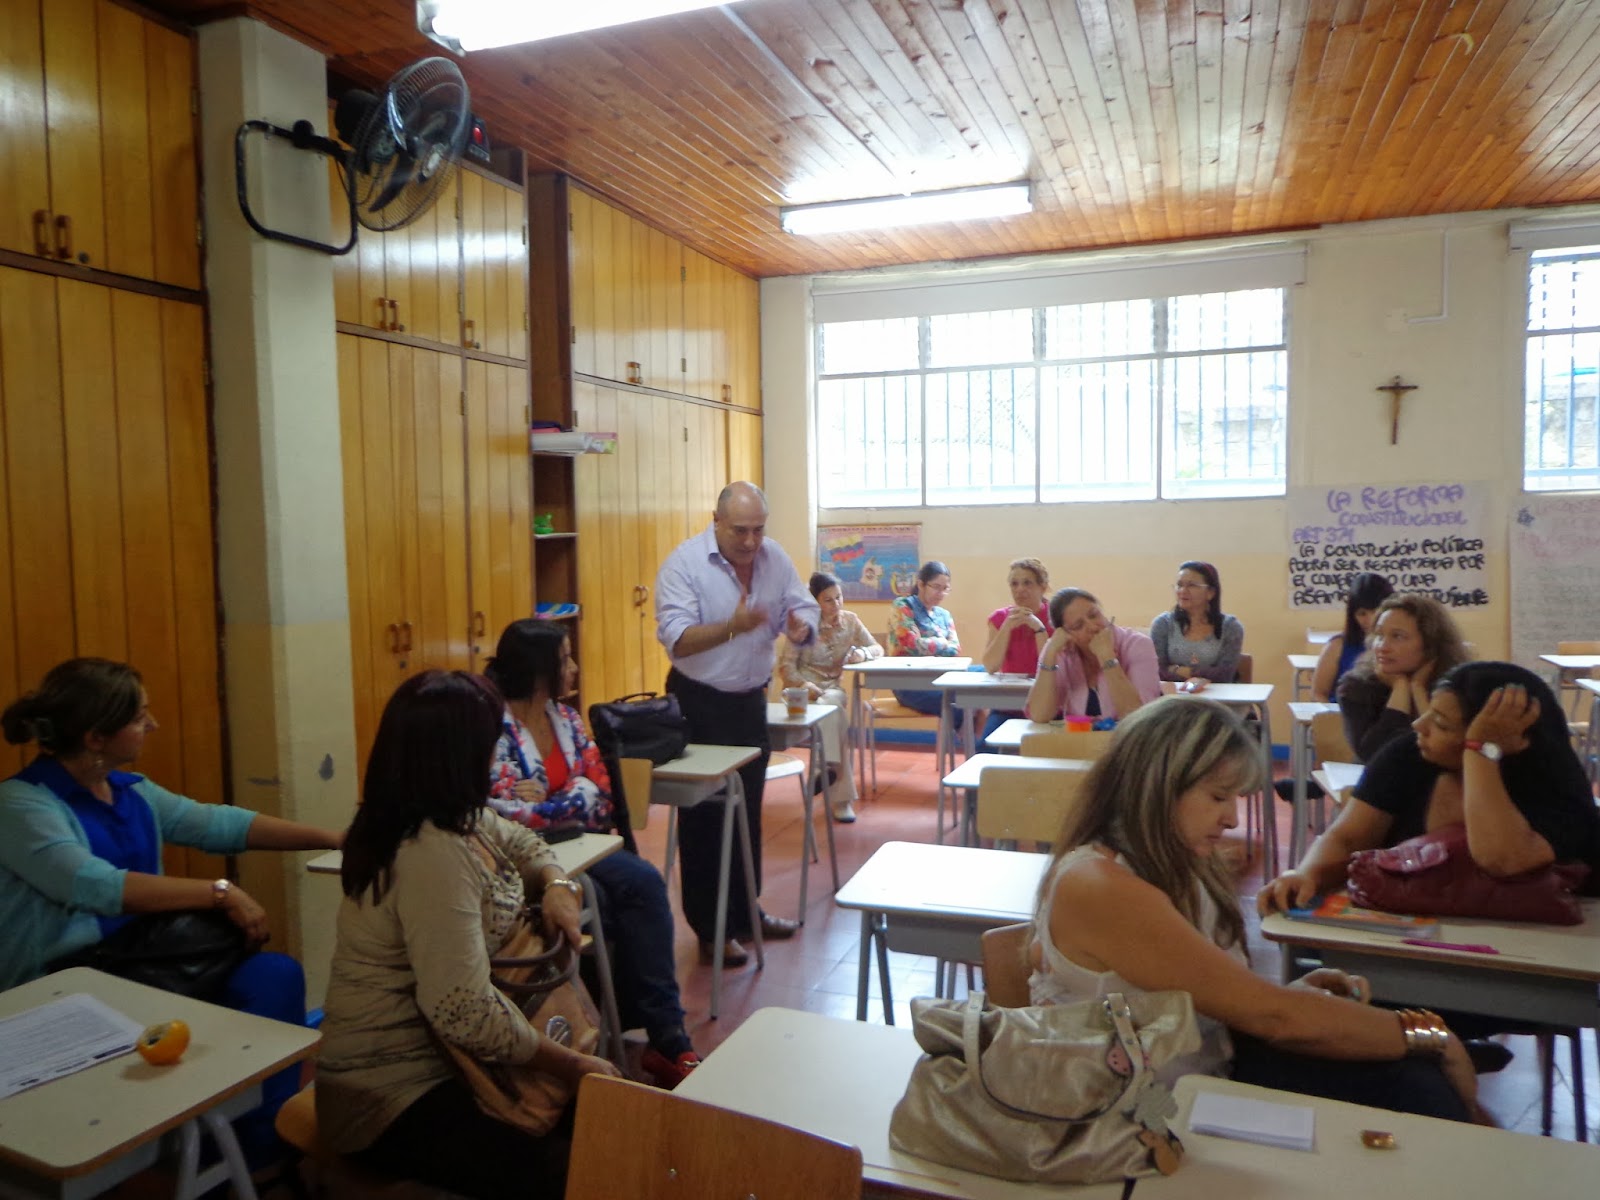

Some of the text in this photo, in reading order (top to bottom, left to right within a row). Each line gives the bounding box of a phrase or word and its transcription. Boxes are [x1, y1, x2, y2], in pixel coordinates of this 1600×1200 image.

[1327, 485, 1464, 513] LA REFORMA
[1300, 544, 1315, 558] LA
[1422, 535, 1483, 554] POLÍTICA
[1334, 558, 1360, 571] SER
[1364, 556, 1454, 572] REFORMADA
[1458, 553, 1485, 571] POR
[1402, 573, 1436, 587] UNA
